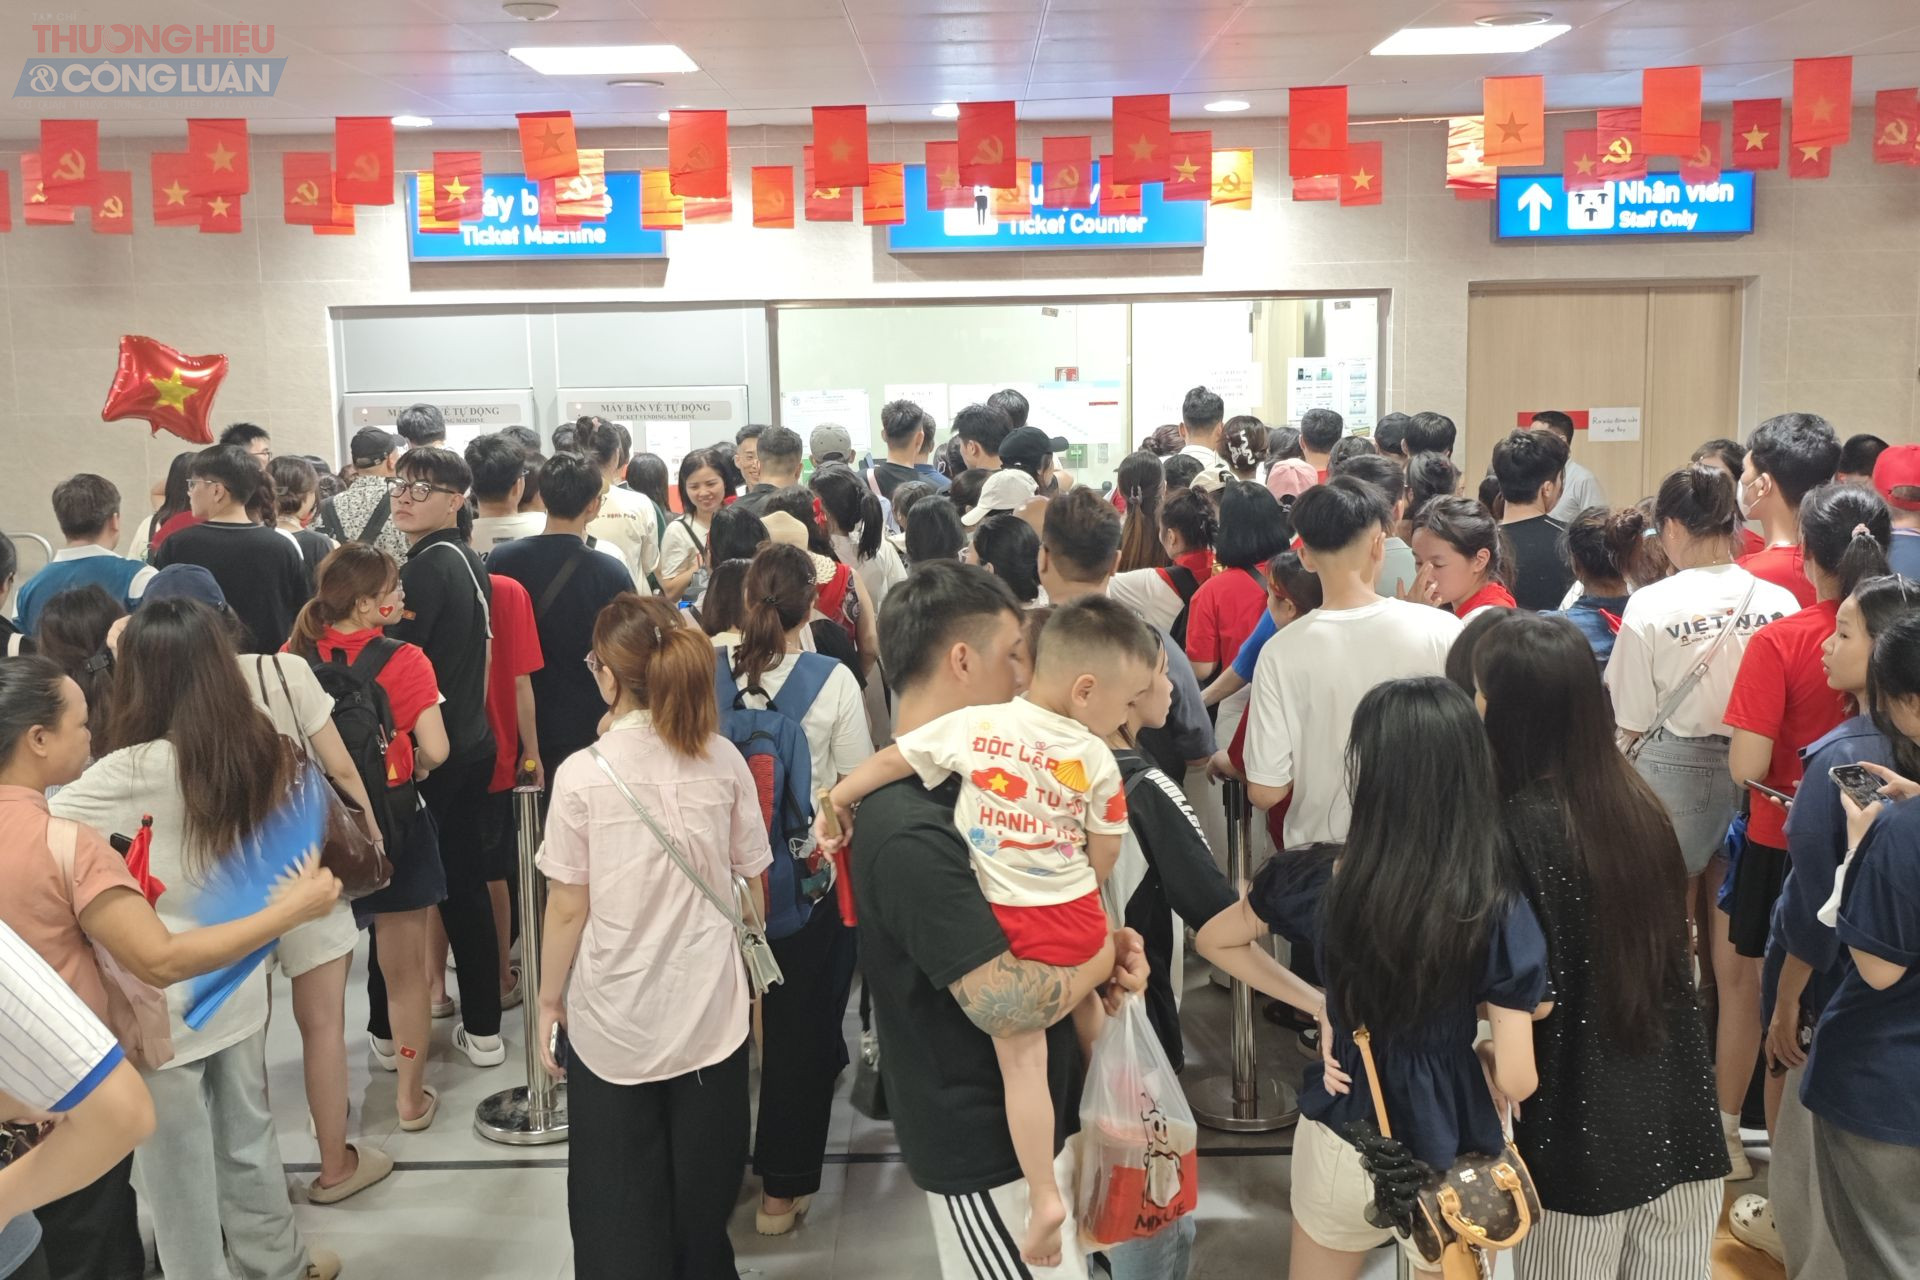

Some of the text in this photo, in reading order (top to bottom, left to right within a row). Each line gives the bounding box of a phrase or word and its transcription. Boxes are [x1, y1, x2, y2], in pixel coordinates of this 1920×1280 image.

[1618, 179, 1735, 205] Nhân viên
[1070, 213, 1149, 234] Counter
[1618, 209, 1698, 231] Staff Only
[460, 223, 607, 246] Ticket Machine
[972, 735, 1060, 771] ĐỘC LẬP
[979, 806, 1037, 836] HẠNH
